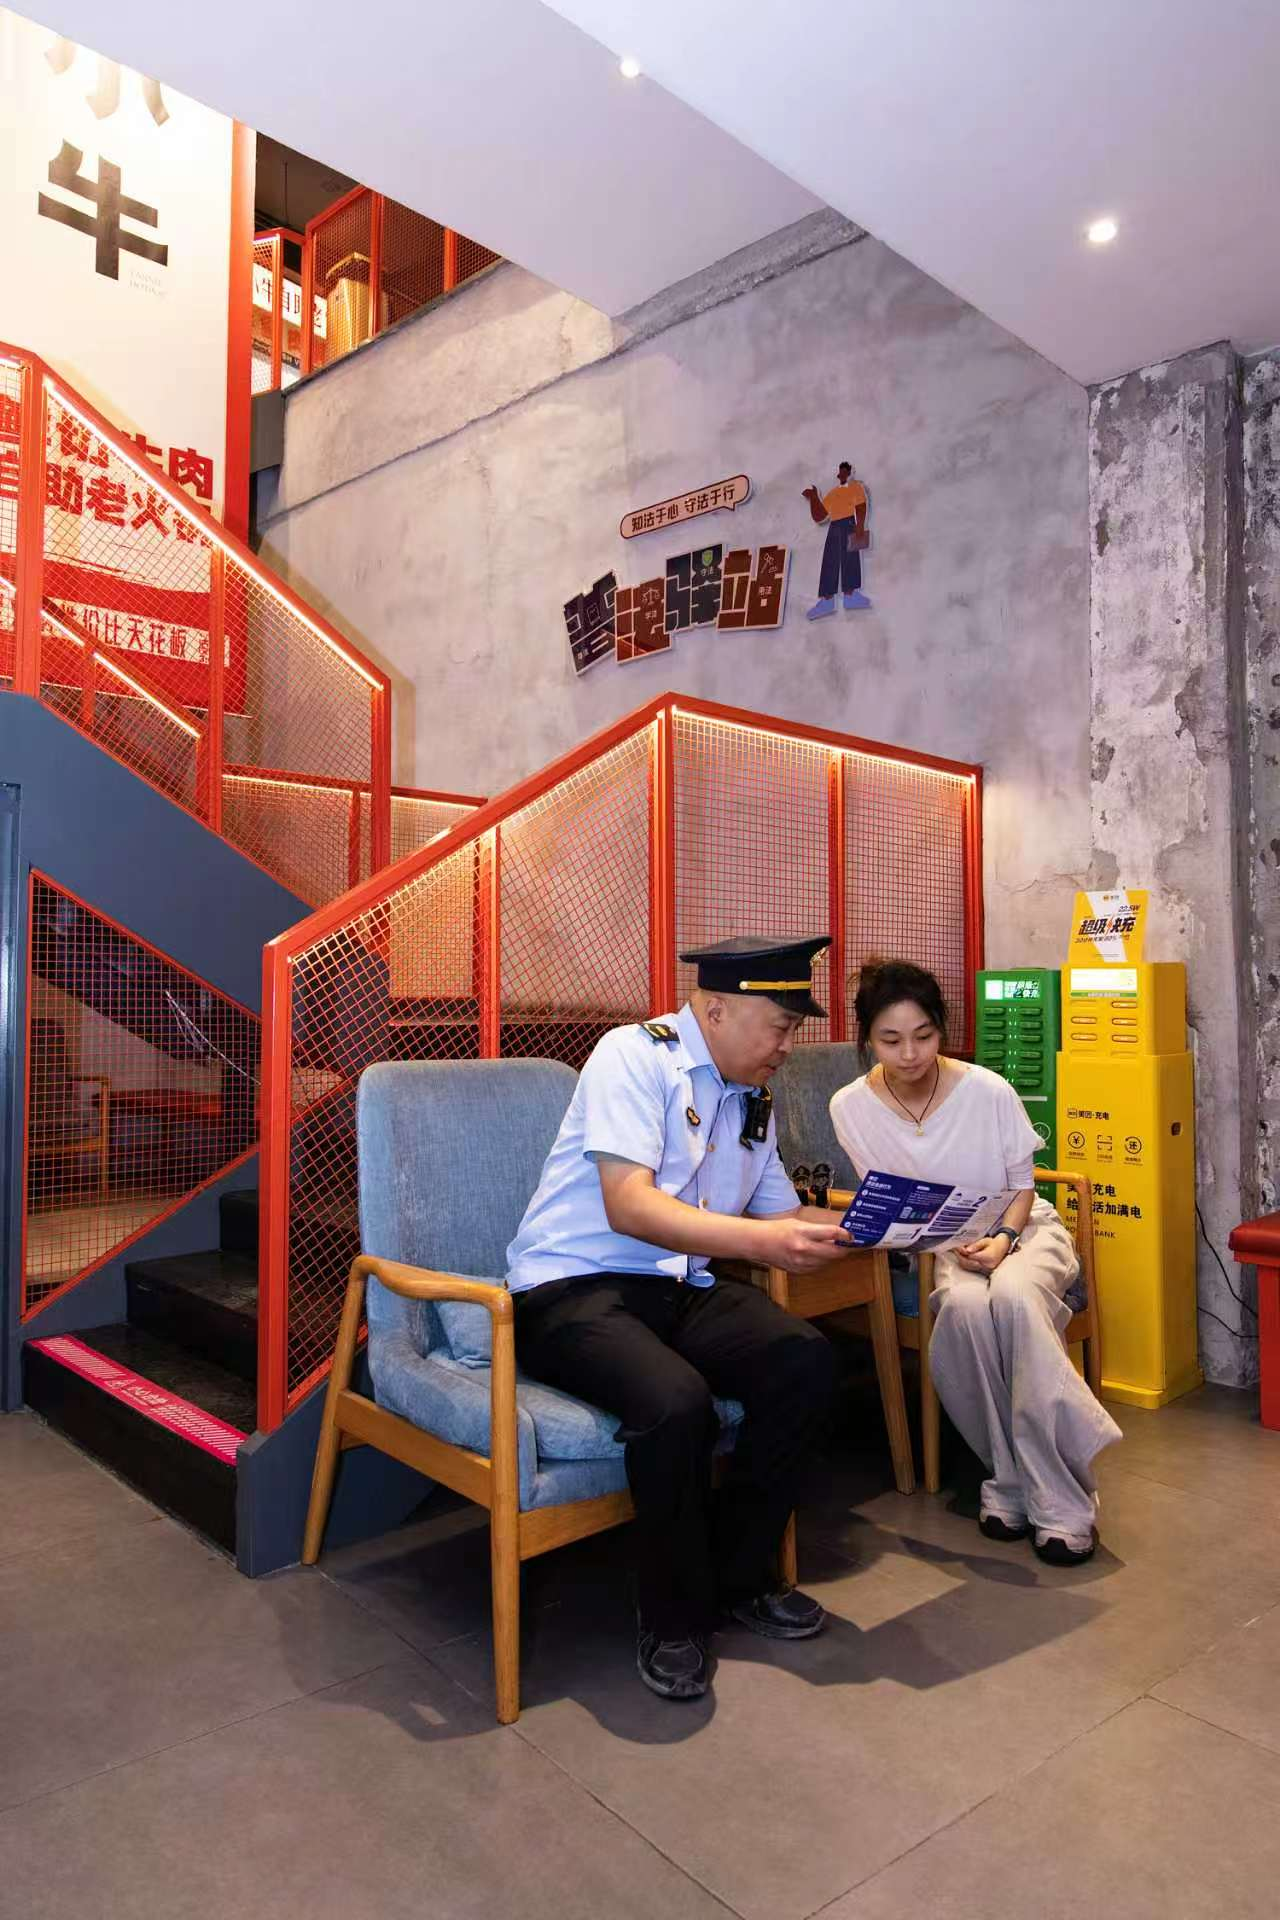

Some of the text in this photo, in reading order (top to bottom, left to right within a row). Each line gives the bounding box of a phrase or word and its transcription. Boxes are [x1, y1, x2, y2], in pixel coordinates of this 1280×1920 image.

[631, 484, 735, 532] 知法于心 守法于行
[972, 1195, 987, 1207] 2
[1066, 1198, 1142, 1219] 给活加满电
